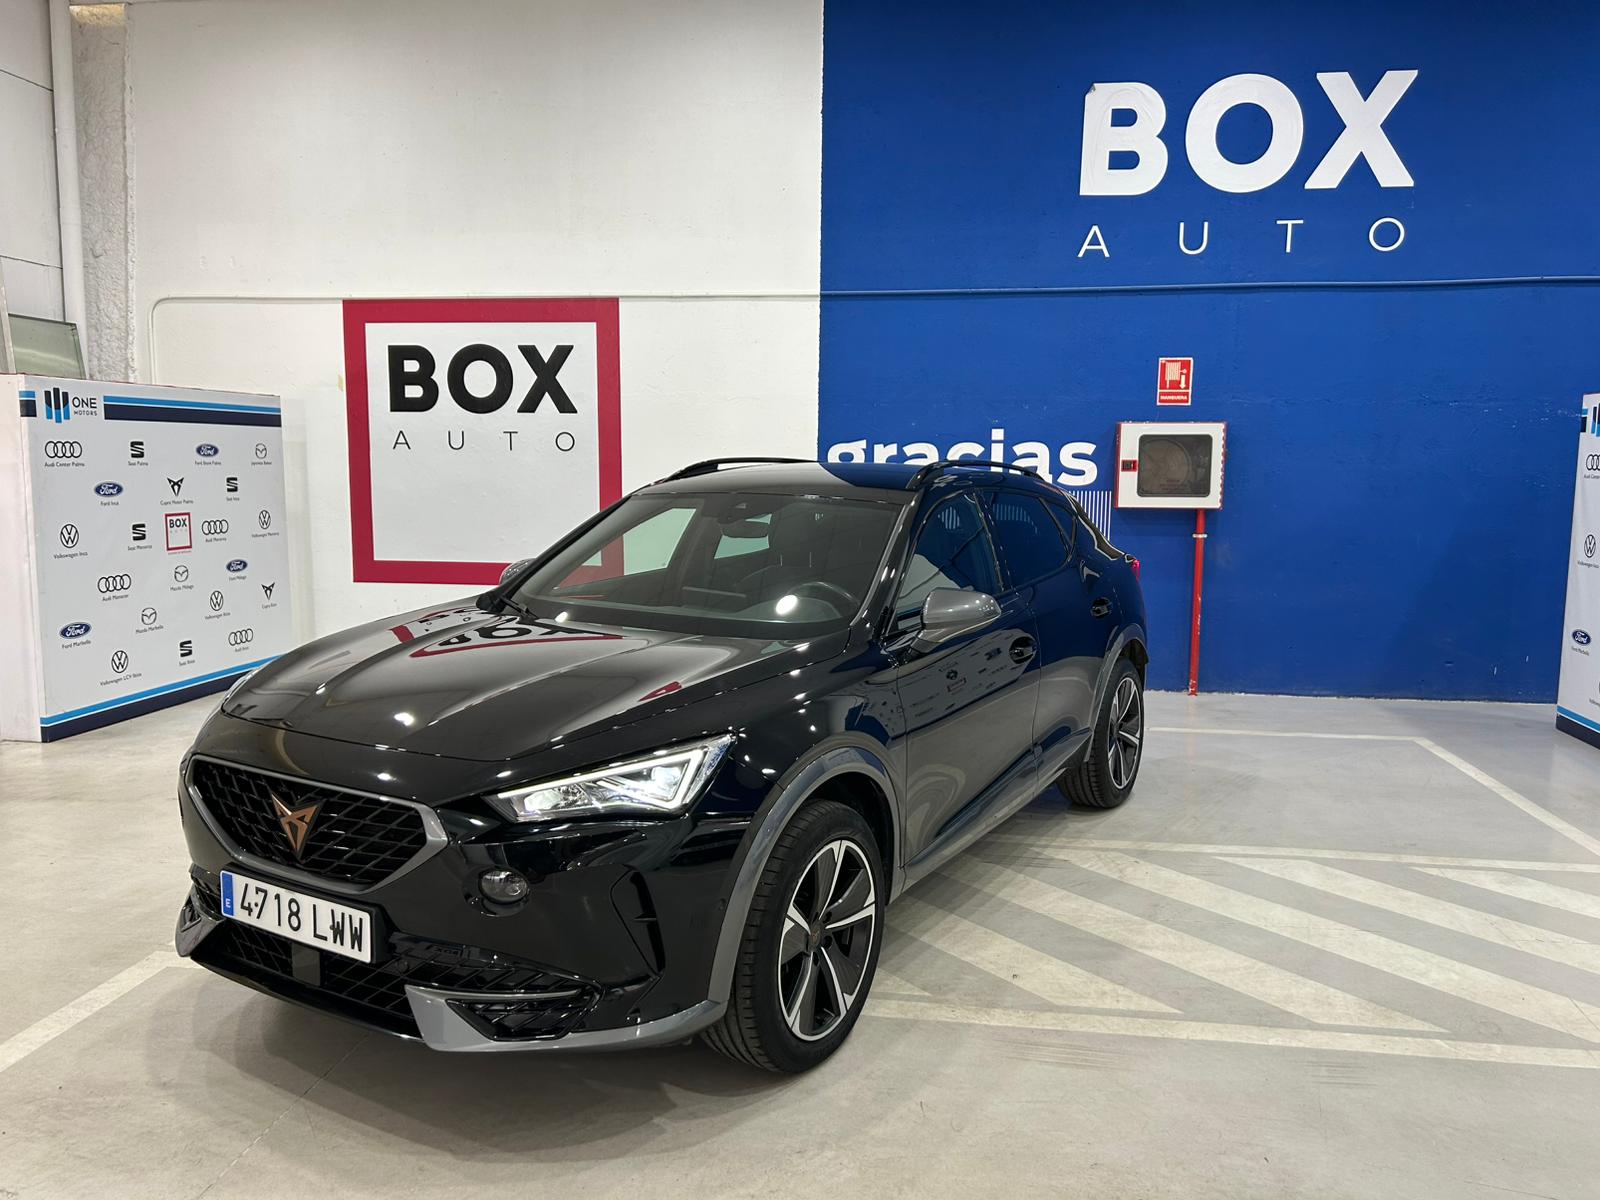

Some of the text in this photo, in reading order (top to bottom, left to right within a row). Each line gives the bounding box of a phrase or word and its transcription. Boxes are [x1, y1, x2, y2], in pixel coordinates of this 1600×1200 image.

[1079, 69, 1419, 196] BOX
[1077, 217, 1406, 258] AUTO
[387, 343, 578, 415] BOX
[72, 396, 98, 408] ONE
[392, 430, 576, 452] AUTO
[169, 518, 187, 528] BOX
[226, 883, 363, 953] E 4718 LWW
